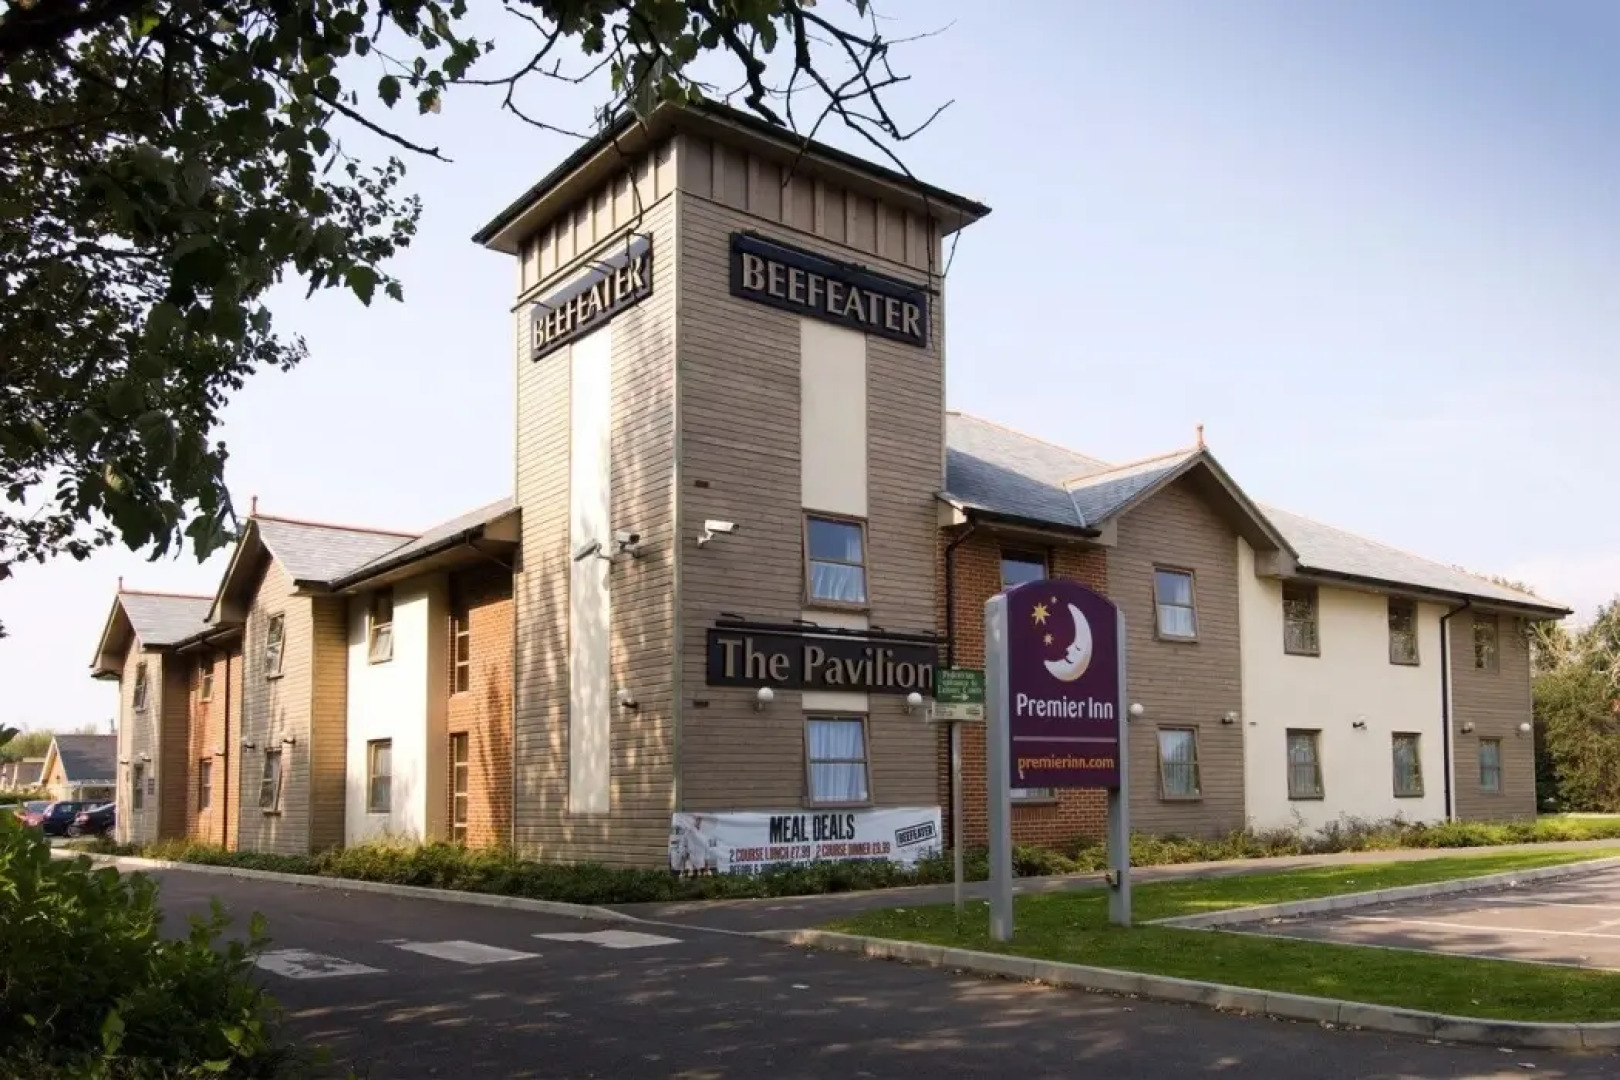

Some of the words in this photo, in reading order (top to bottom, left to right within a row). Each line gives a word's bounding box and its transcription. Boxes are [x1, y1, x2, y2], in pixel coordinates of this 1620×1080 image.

[533, 256, 645, 350] BEEFEATER
[741, 251, 922, 340] BEEFEATER
[717, 636, 791, 682] The
[802, 644, 934, 690] Pavilion
[1016, 692, 1086, 719] Premier
[1088, 696, 1114, 720] Inn
[1017, 754, 1115, 775] premierinn.com
[769, 815, 809, 844] MEAL
[812, 813, 855, 841] DEALS
[735, 847, 764, 862] COURSE
[822, 843, 847, 857] COURSE
